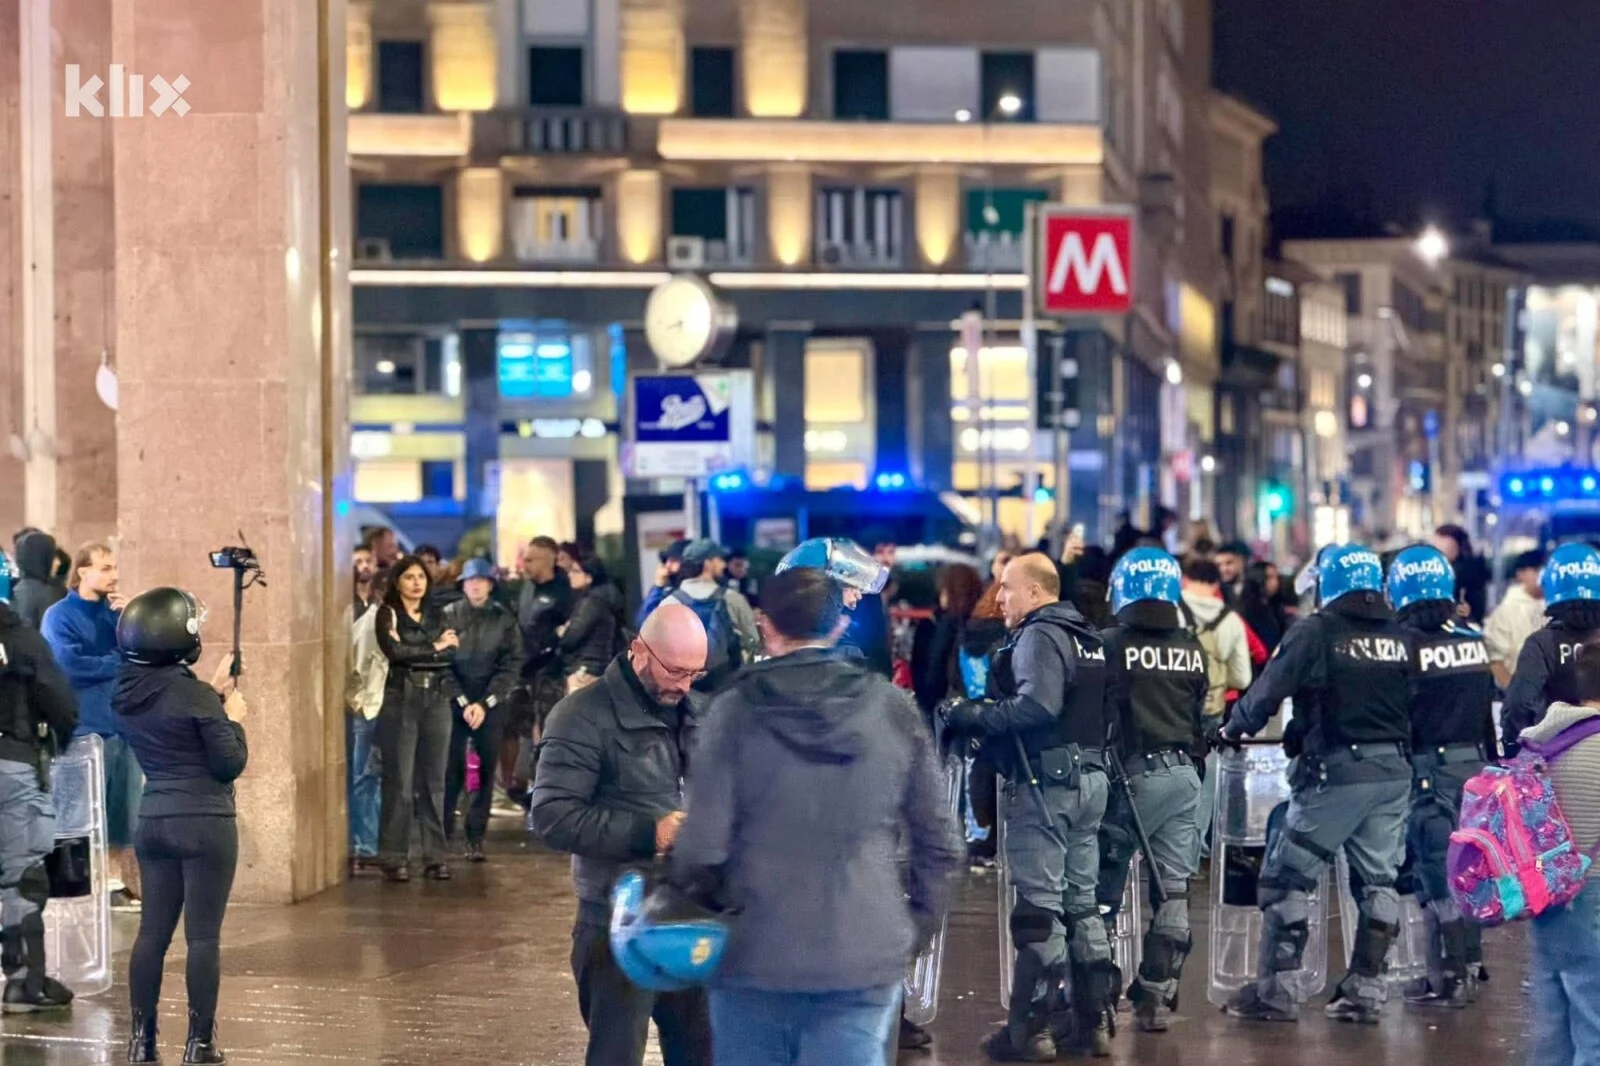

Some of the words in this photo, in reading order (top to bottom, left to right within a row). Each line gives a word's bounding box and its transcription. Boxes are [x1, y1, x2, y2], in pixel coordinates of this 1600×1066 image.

[1048, 231, 1128, 295] M
[1398, 556, 1445, 581] POLIZIA
[1125, 646, 1204, 673] POLIZIA
[1420, 641, 1490, 671] POLIZIA
